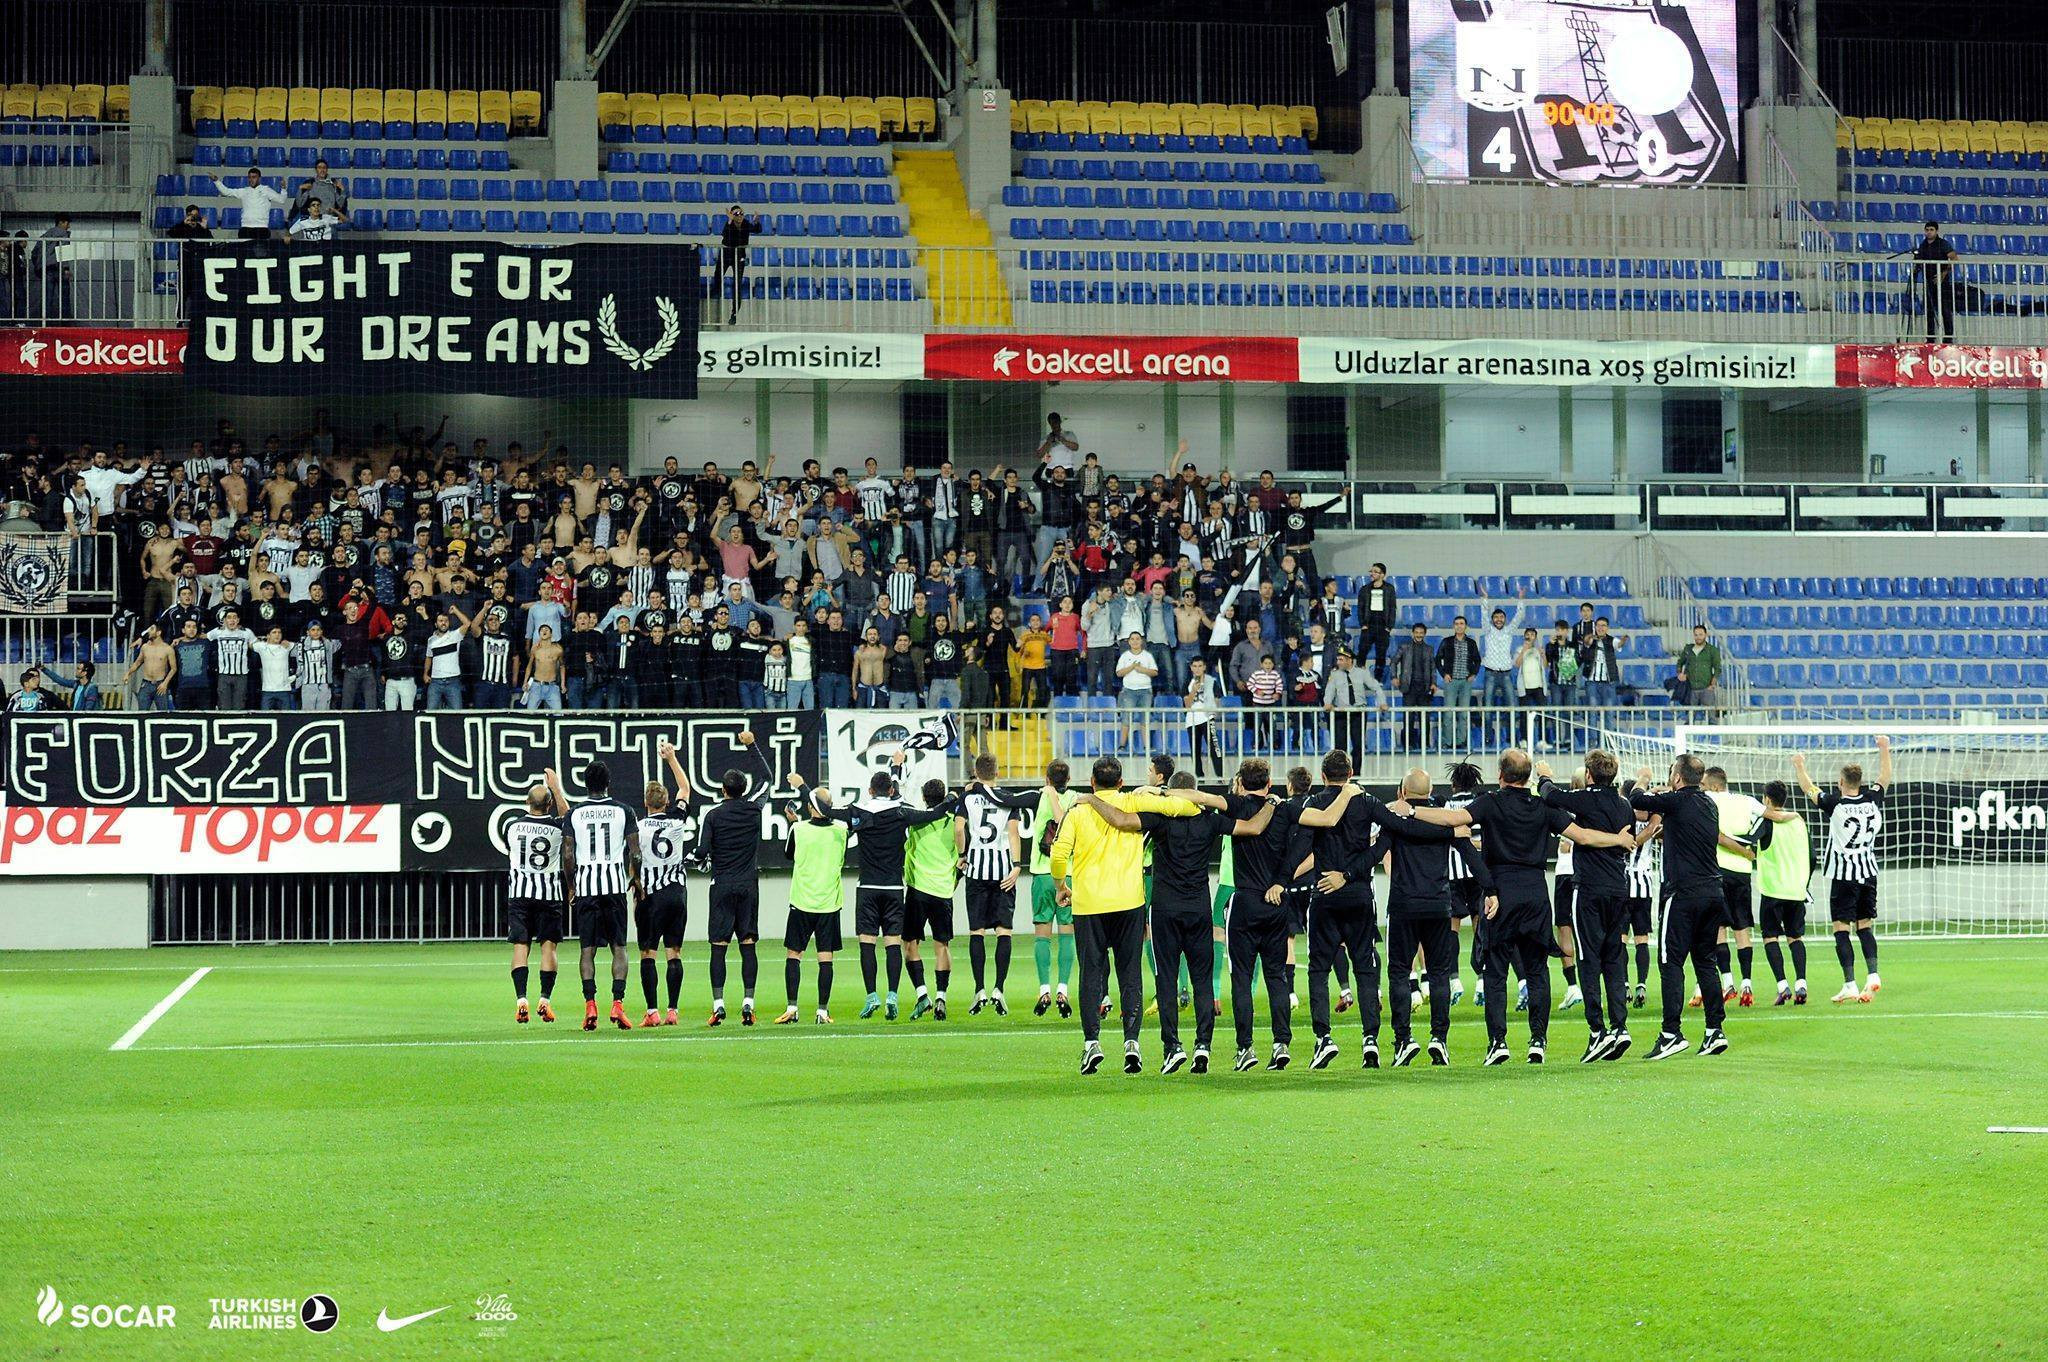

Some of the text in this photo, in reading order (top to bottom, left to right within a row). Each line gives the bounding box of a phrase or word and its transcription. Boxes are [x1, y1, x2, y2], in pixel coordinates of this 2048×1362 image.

[1543, 101, 1615, 127] 90:00
[1481, 126, 1517, 173] 4
[1637, 128, 1668, 176] 0
[55, 339, 169, 366] bakcell
[205, 316, 325, 363] OUR
[362, 315, 590, 365] DREAMS
[726, 344, 882, 374] gəlmisiniz!
[1026, 347, 1230, 376] bakcell arena
[1334, 350, 1796, 385] Ulduzlar arenasına xoş gəlmisiniz!
[1927, 354, 2023, 378] bakcell
[515, 824, 557, 837] AXUNDOV
[586, 822, 611, 862] 11
[651, 827, 674, 860] 6
[979, 807, 998, 845] 5
[1843, 814, 1875, 850] 25
[516, 834, 552, 872] 18
